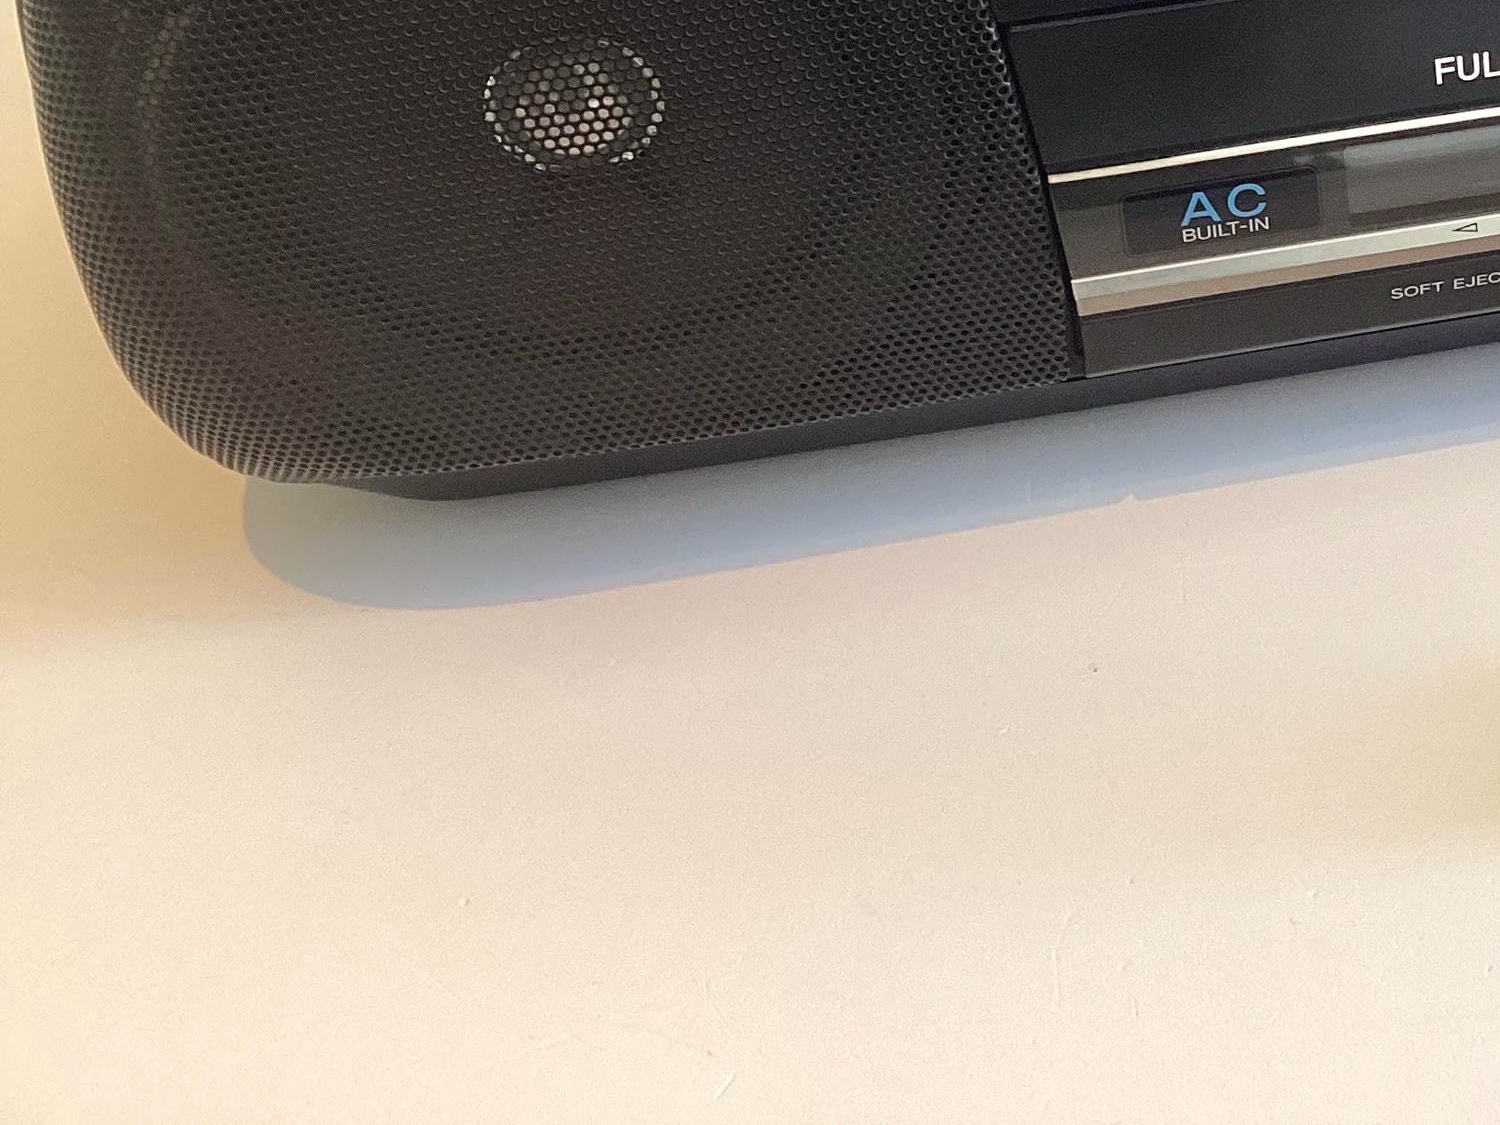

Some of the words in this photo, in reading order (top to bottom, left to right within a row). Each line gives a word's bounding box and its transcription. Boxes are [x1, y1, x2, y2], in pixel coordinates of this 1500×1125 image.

[1181, 182, 1267, 227] AC
[1182, 216, 1270, 243] BUILT-IN
[1390, 280, 1445, 301] SOFT
